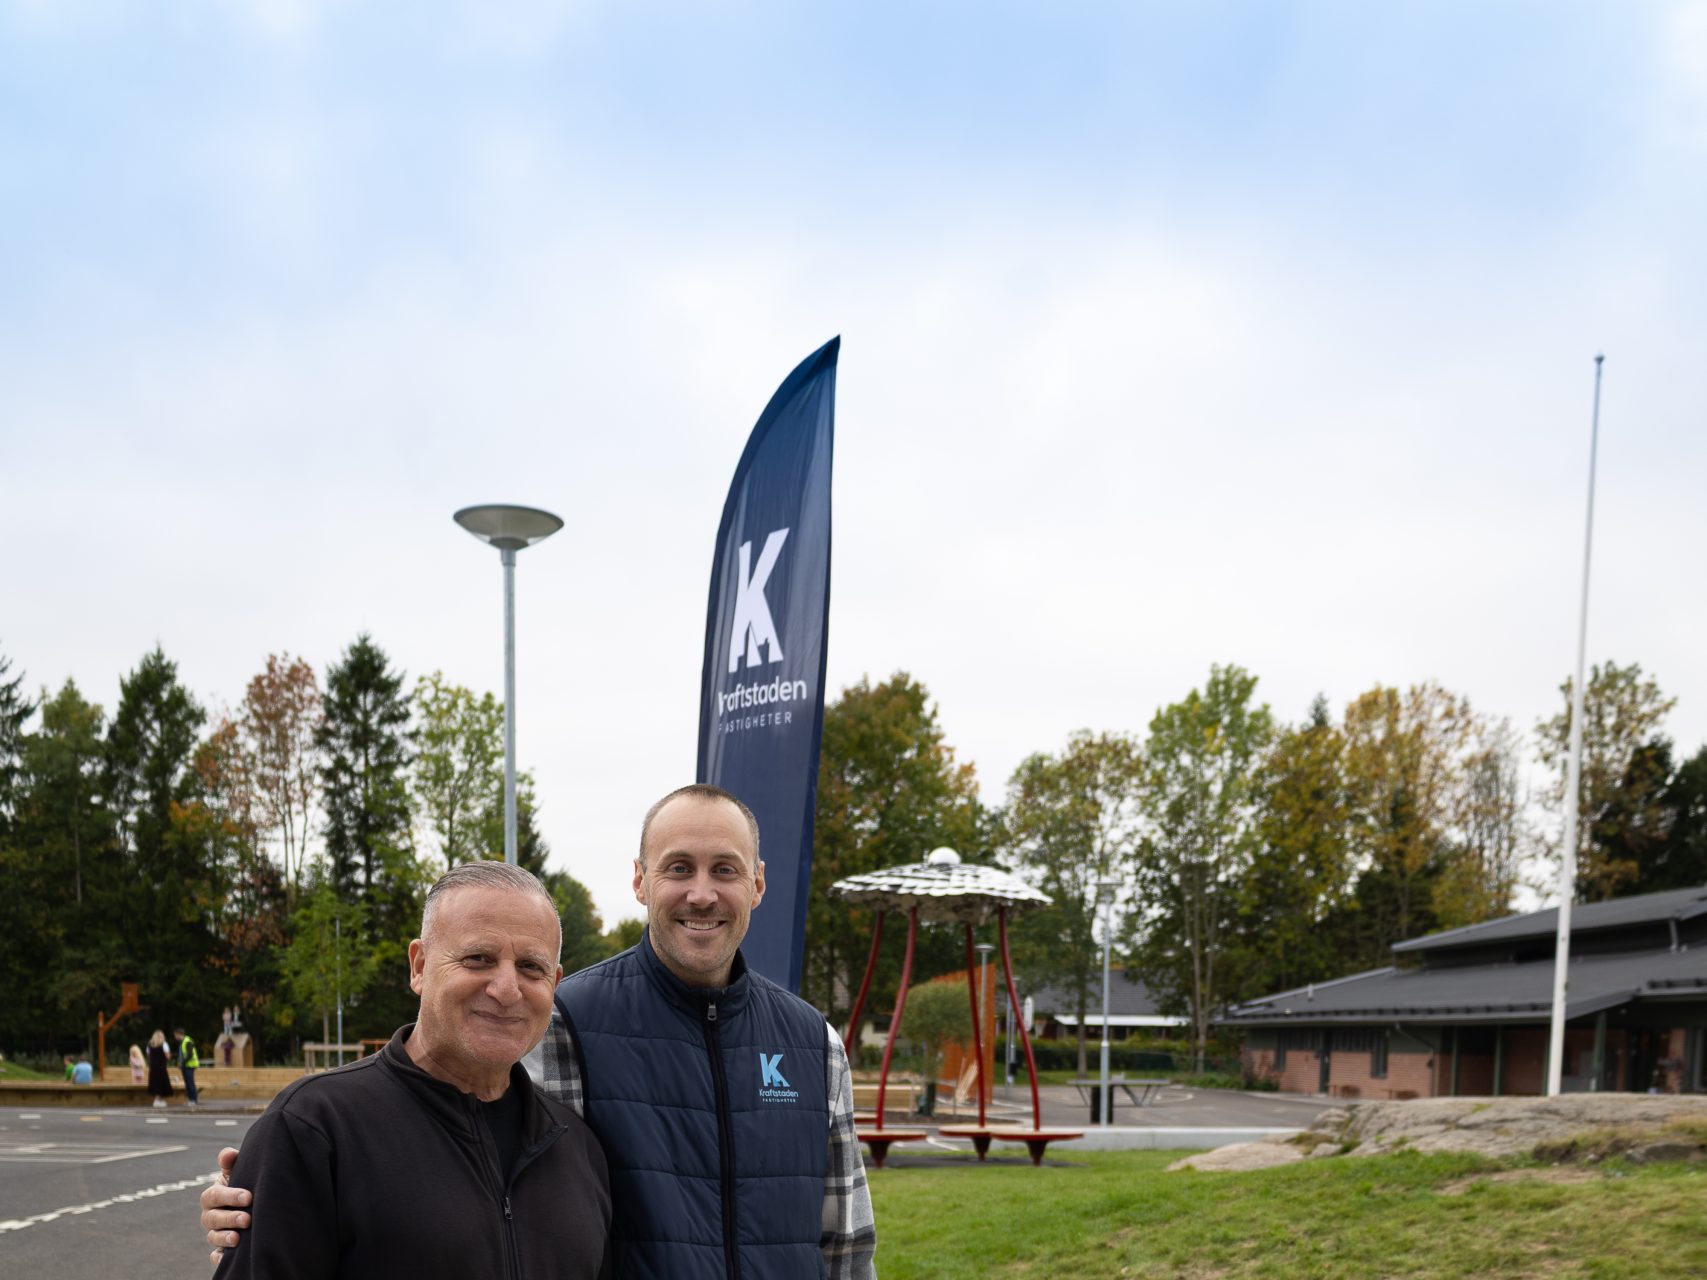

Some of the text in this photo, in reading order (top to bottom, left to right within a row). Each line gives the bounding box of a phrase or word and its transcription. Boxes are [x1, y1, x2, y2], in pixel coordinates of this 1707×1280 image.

[728, 527, 790, 673] K
[759, 1052, 790, 1088] K
[758, 1088, 799, 1098] Kraftstaden
